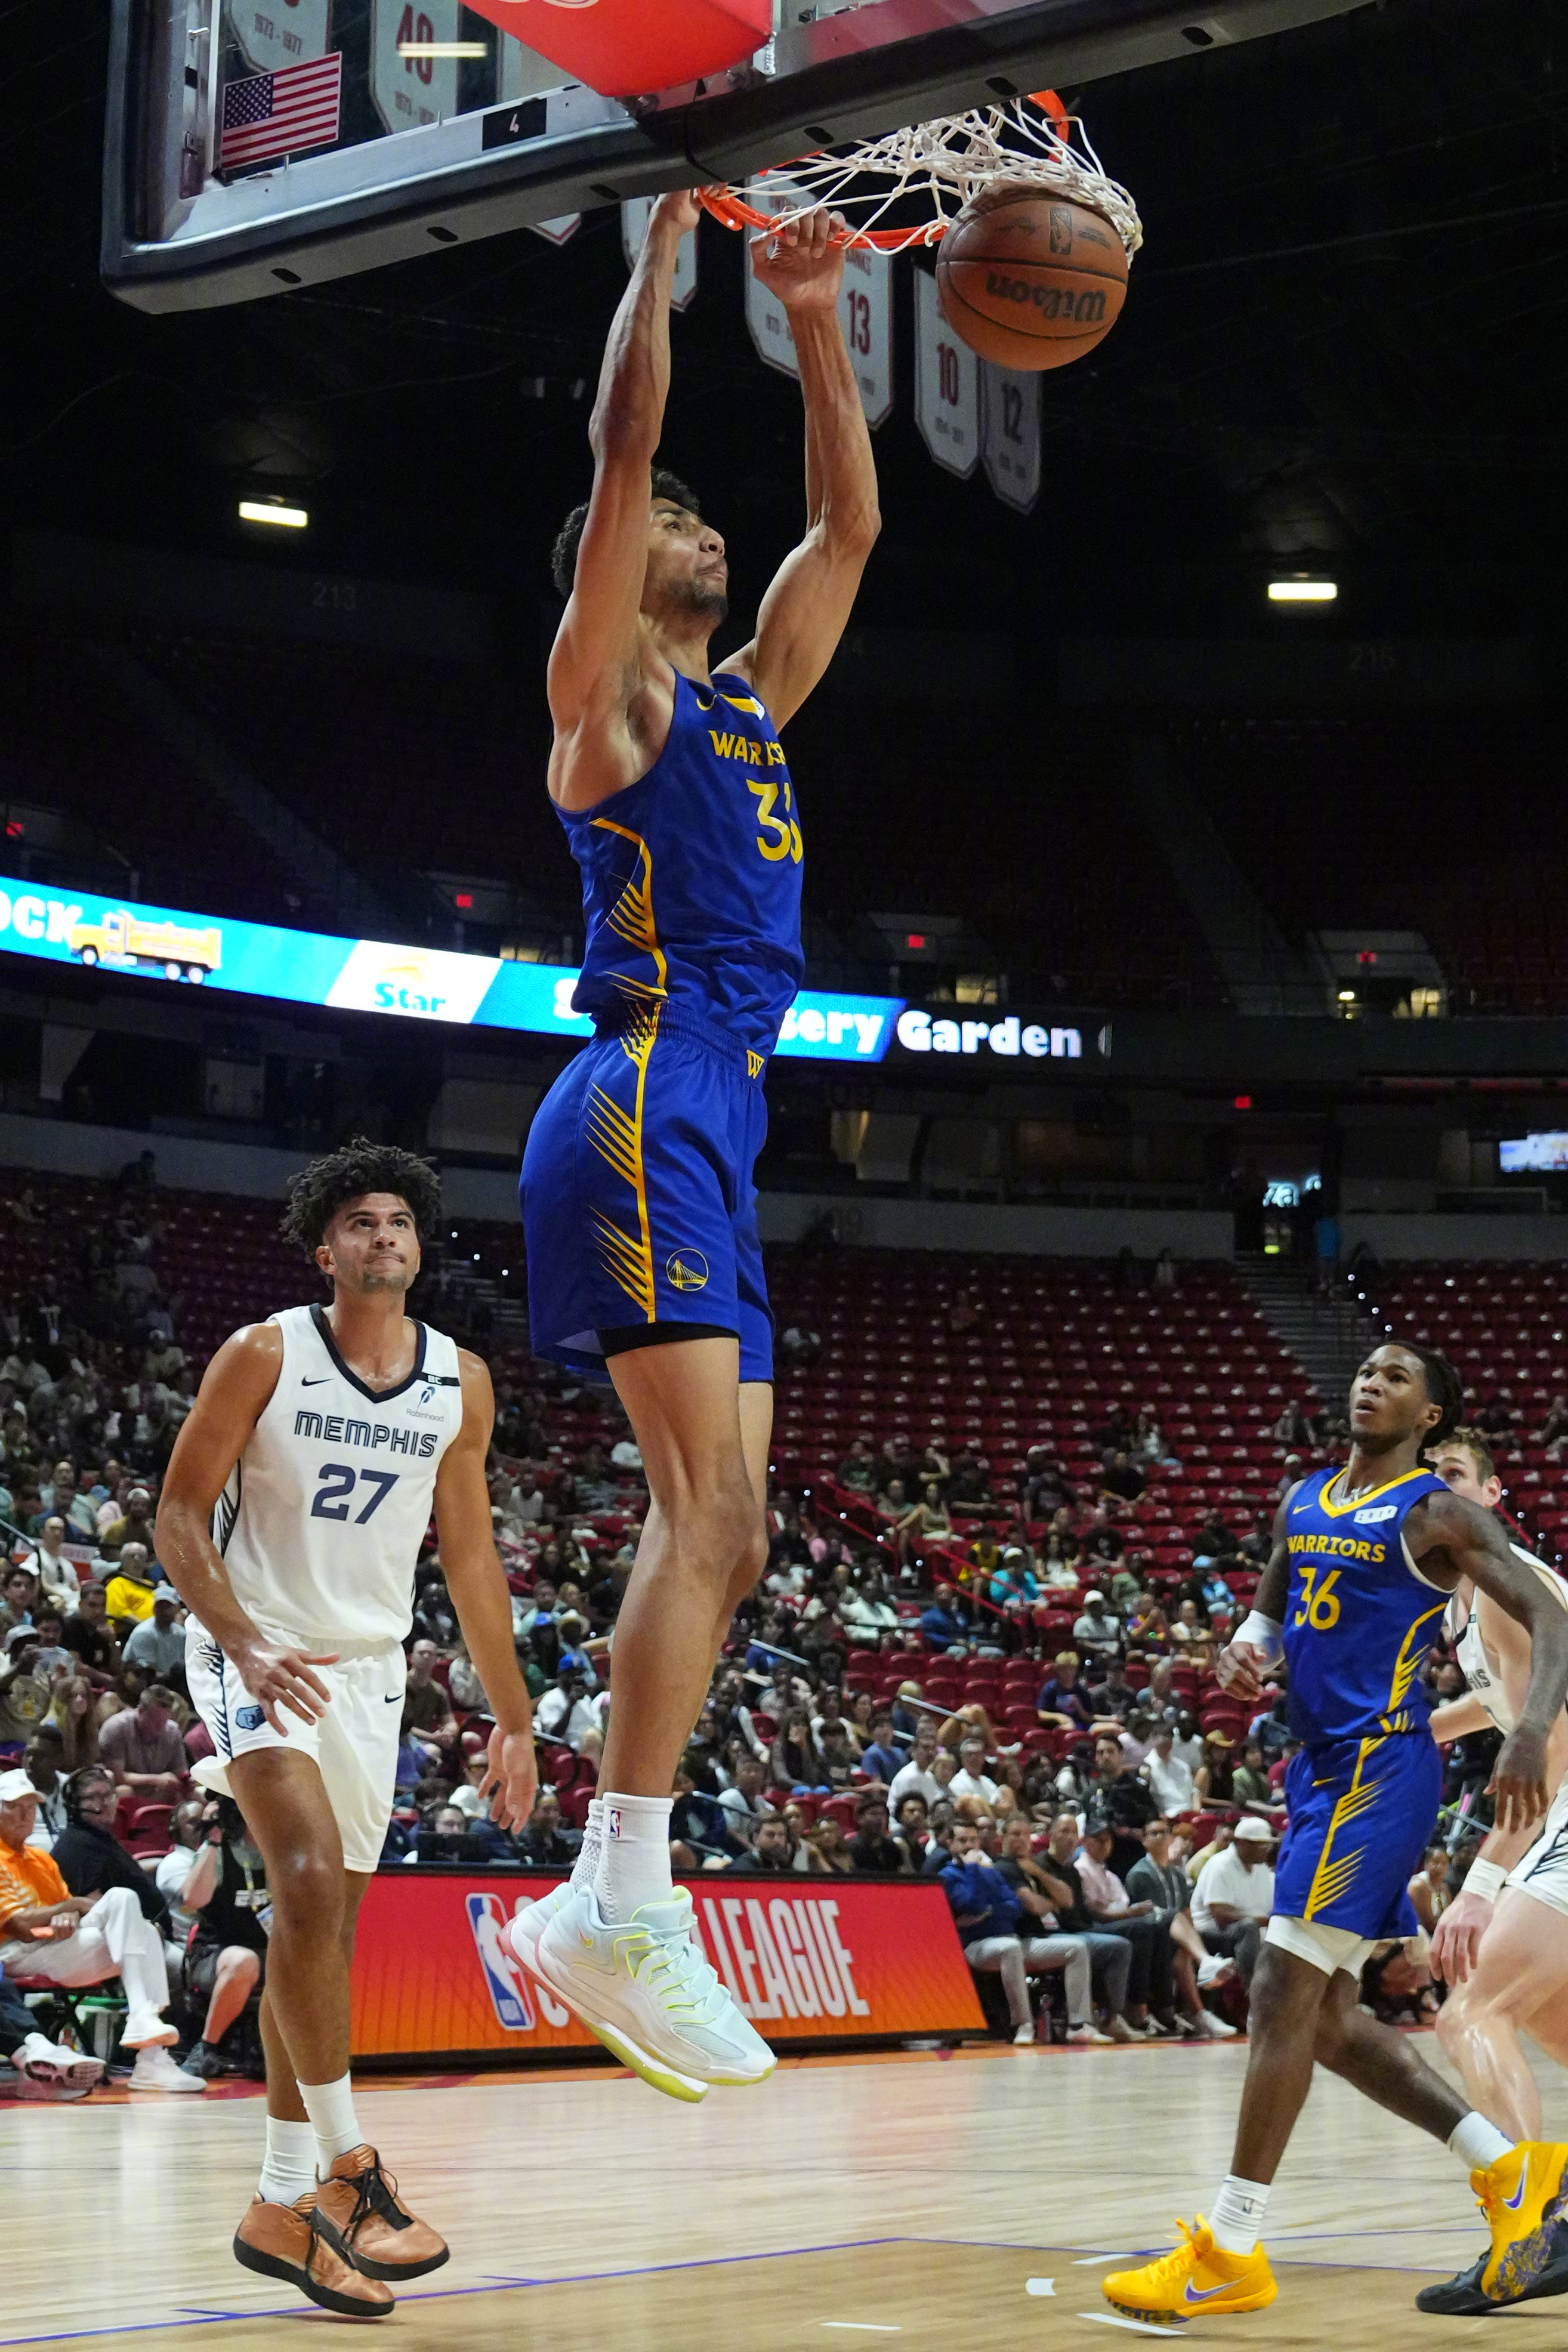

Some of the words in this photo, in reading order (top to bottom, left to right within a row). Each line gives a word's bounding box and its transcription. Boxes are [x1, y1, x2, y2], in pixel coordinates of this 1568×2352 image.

[847, 288, 871, 356] 13
[986, 271, 1106, 323] Wilson
[937, 342, 959, 406] 10
[375, 981, 446, 1013] Star
[897, 1010, 1082, 1058] Garden
[428, 1375, 442, 1385] BC
[294, 1410, 438, 1457] MEMPHIS
[406, 1408, 444, 1422] Robinhood
[310, 1463, 400, 1524] 27
[1286, 1534, 1386, 1563] WARRIORS
[1294, 1567, 1342, 1630] 36
[702, 1897, 871, 2018] LEAGUE
